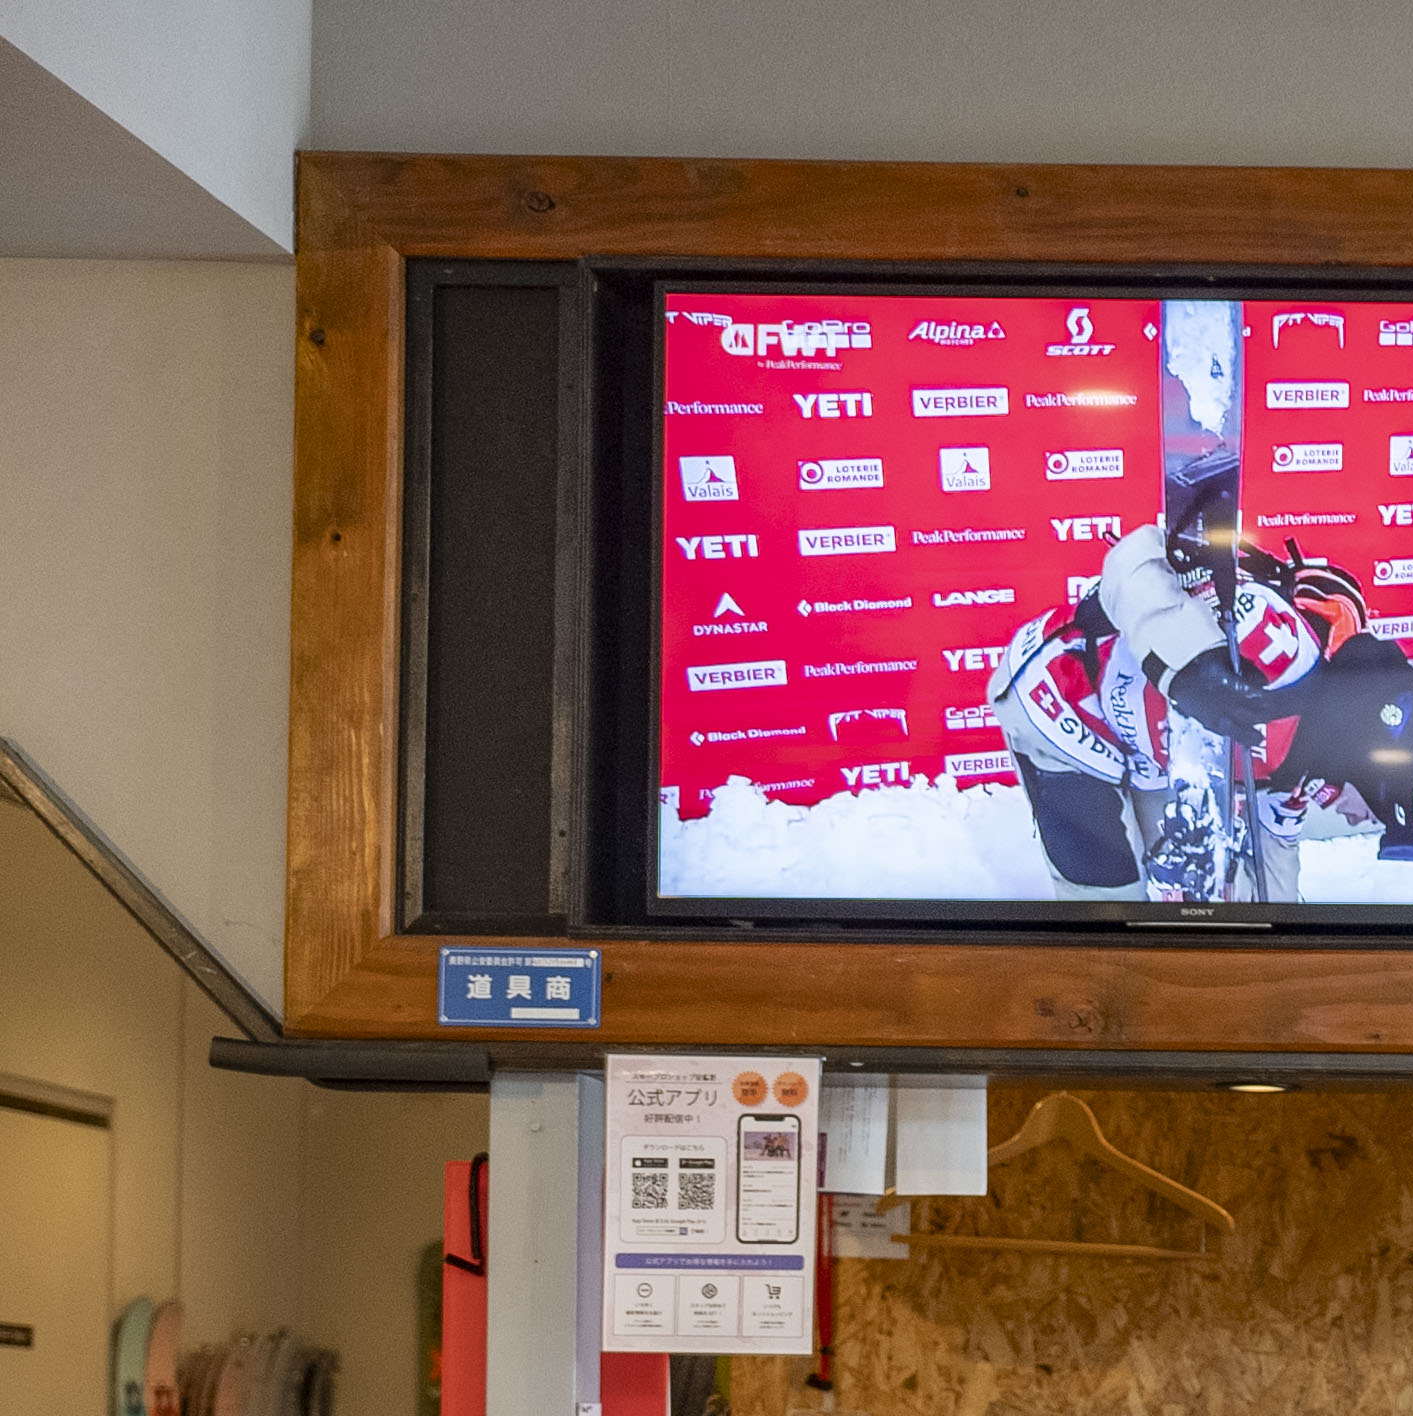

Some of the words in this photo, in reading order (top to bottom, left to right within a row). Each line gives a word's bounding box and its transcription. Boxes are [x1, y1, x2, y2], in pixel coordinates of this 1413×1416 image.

[909, 319, 986, 341] Alpina
[1045, 345, 1116, 356] SCOTT
[793, 392, 873, 418] YETI
[919, 394, 998, 412] VERBIER
[1025, 393, 1138, 408] PeakPerformance
[1272, 388, 1340, 404] VERBIER
[945, 473, 986, 490] Valais
[687, 483, 734, 499] Valais
[1257, 512, 1356, 527] PeakPerformance
[912, 528, 1026, 546] PeakPerformance
[1052, 516, 1121, 542] YETI
[677, 534, 759, 561] YETI
[805, 533, 885, 552] VERBIER
[814, 600, 854, 614] Black
[856, 596, 912, 611] Diamond
[933, 588, 1015, 608] LANGE
[693, 621, 768, 637] DYNASTAR
[694, 667, 776, 688] VERBIER
[803, 660, 918, 679] PeakPerformance
[707, 730, 745, 743] Black
[747, 725, 806, 740] Diamond
[842, 761, 910, 786] YETI
[466, 973, 572, 1001] 道具商
[627, 1088, 718, 1107] 公式アプリ
